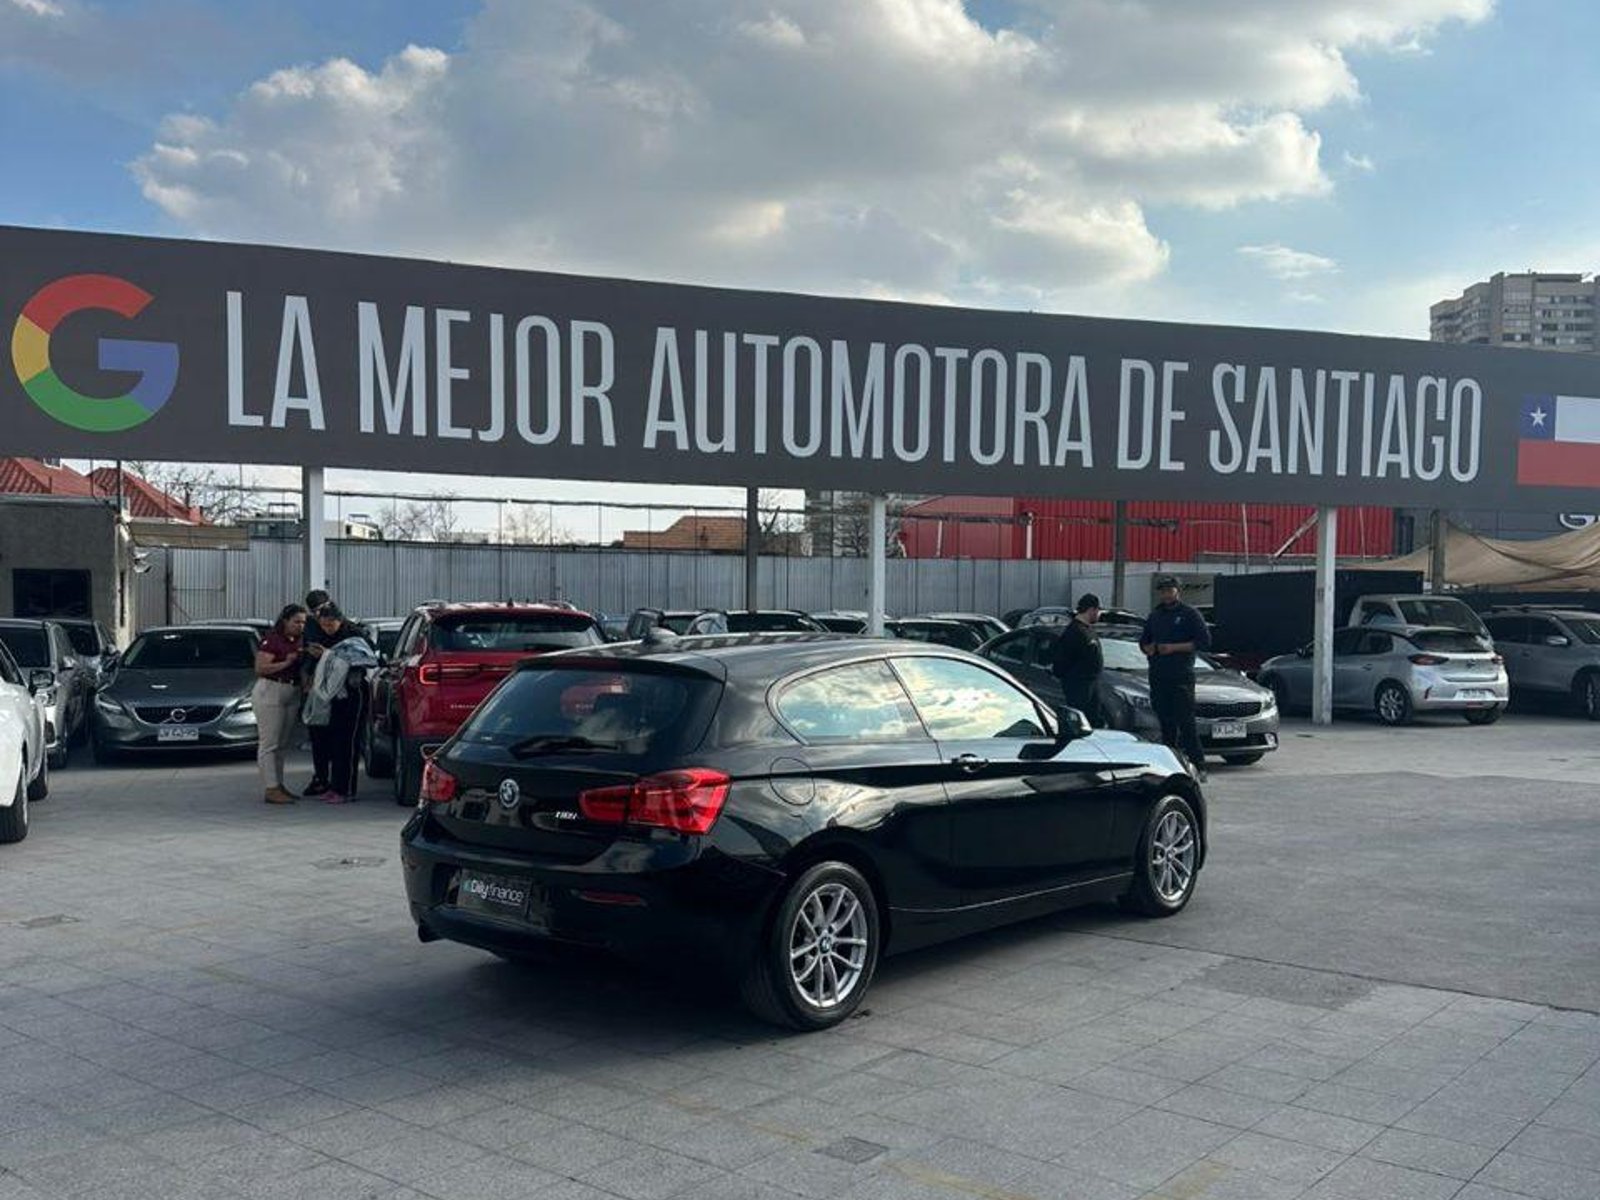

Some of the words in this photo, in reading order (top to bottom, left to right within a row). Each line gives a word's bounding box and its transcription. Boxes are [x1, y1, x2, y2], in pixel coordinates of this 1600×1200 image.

[226, 290, 326, 431] LA
[358, 301, 616, 447] MEJOR
[643, 326, 1093, 468] AUTOMOTORA
[1117, 358, 1189, 471] DE
[1209, 362, 1482, 483] SANTIAGO
